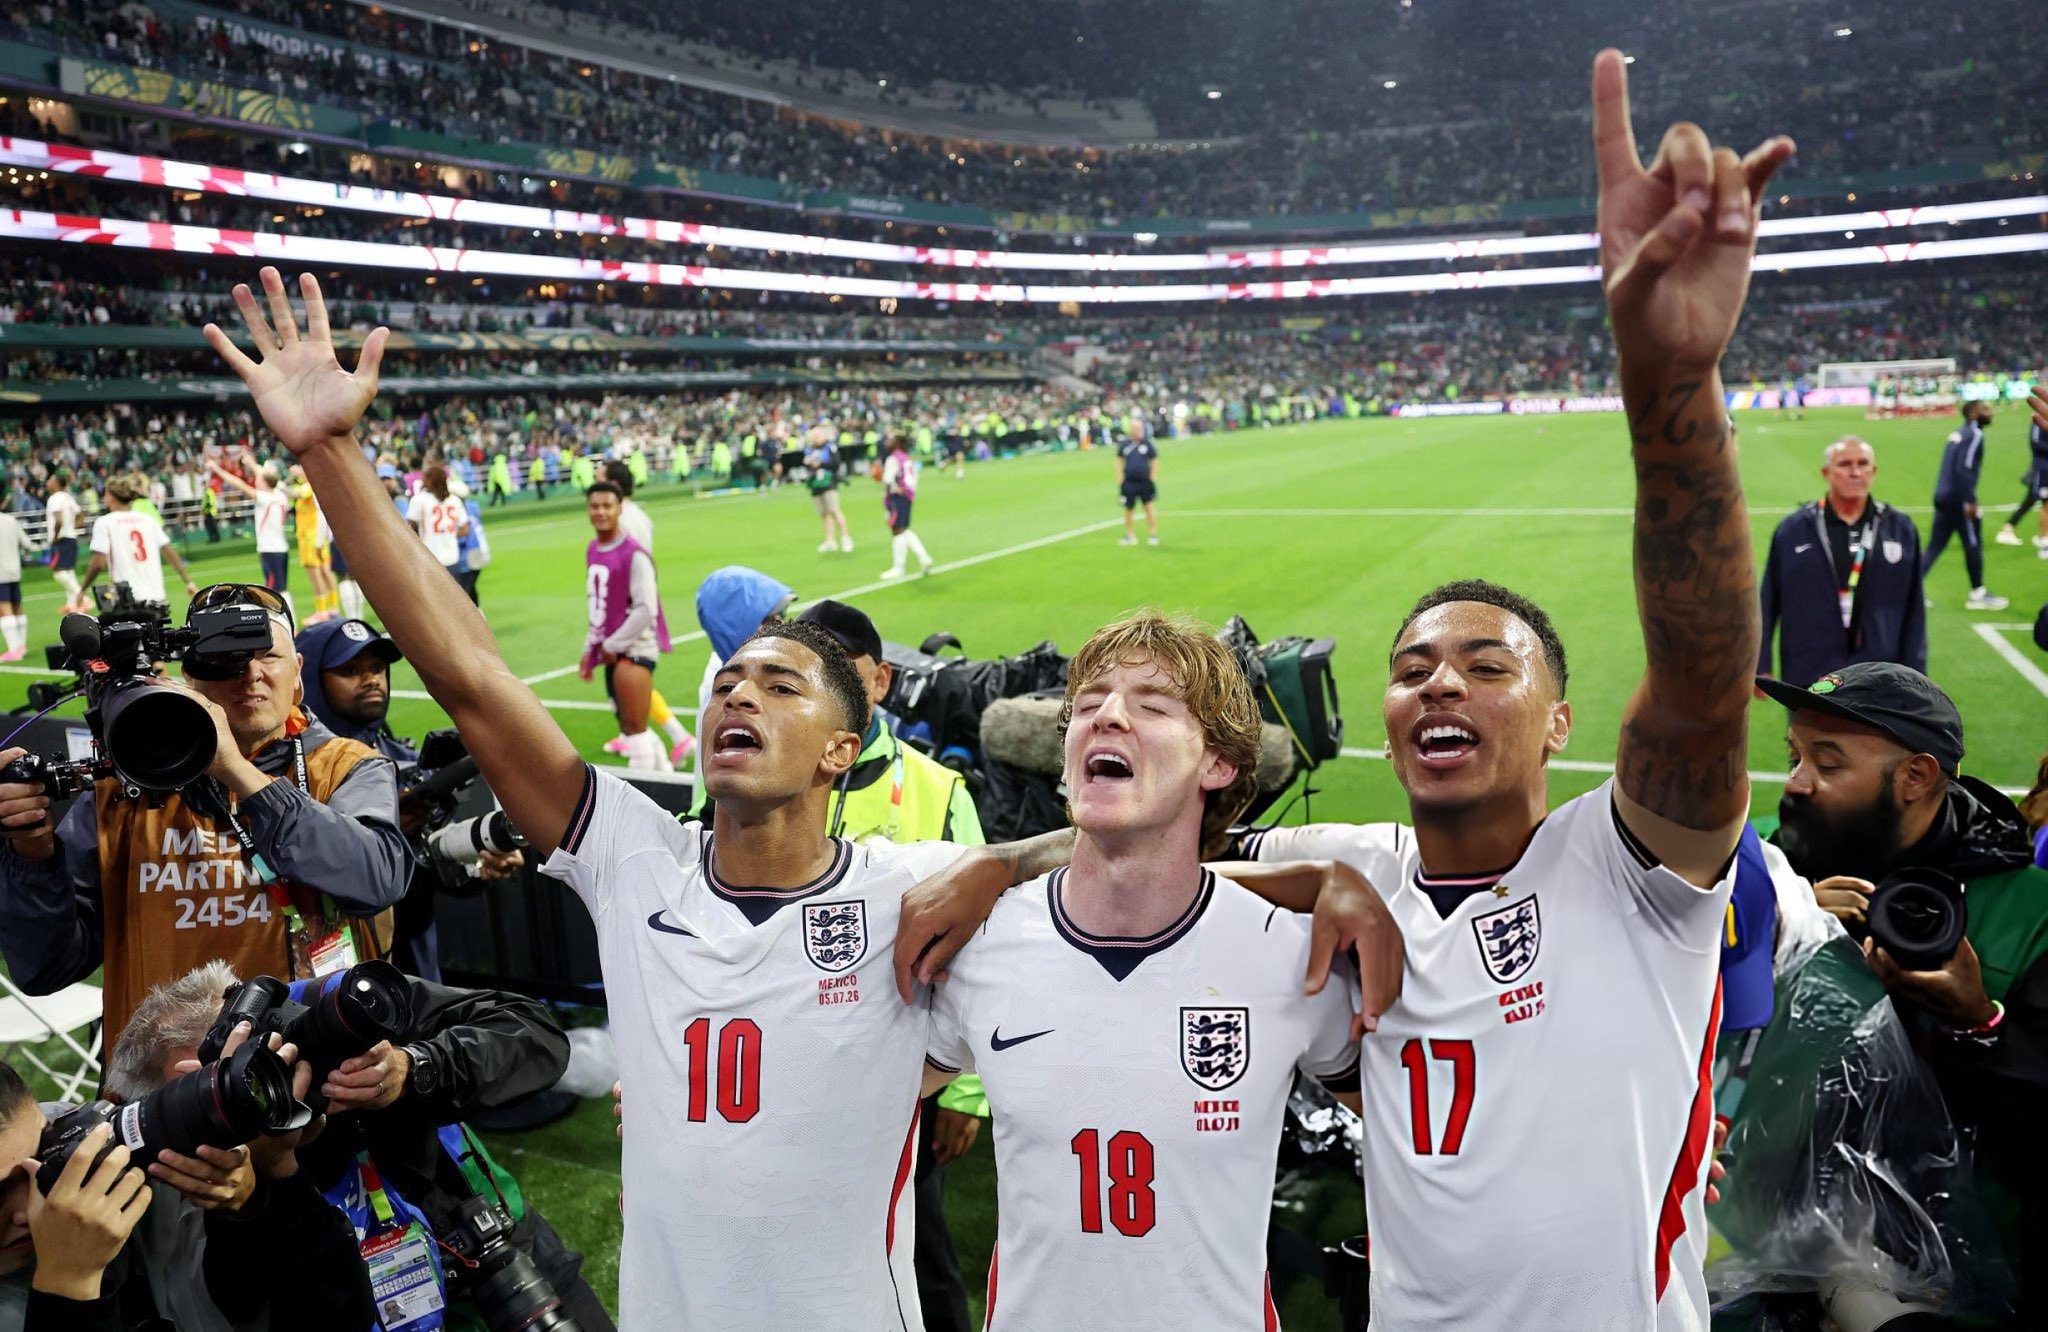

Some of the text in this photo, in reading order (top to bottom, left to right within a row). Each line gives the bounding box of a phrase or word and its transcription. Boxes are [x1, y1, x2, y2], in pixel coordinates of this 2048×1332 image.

[432, 504, 458, 533] 25
[129, 529, 147, 562] 3
[161, 826, 242, 857] MED
[139, 859, 261, 893] PARTN
[174, 892, 272, 930] 2454
[818, 974, 858, 992] MEXICO
[818, 990, 860, 1007] 05.07.26
[683, 1017, 763, 1124] 10
[1400, 1036, 1476, 1157] 17
[1070, 1127, 1156, 1238] 18
